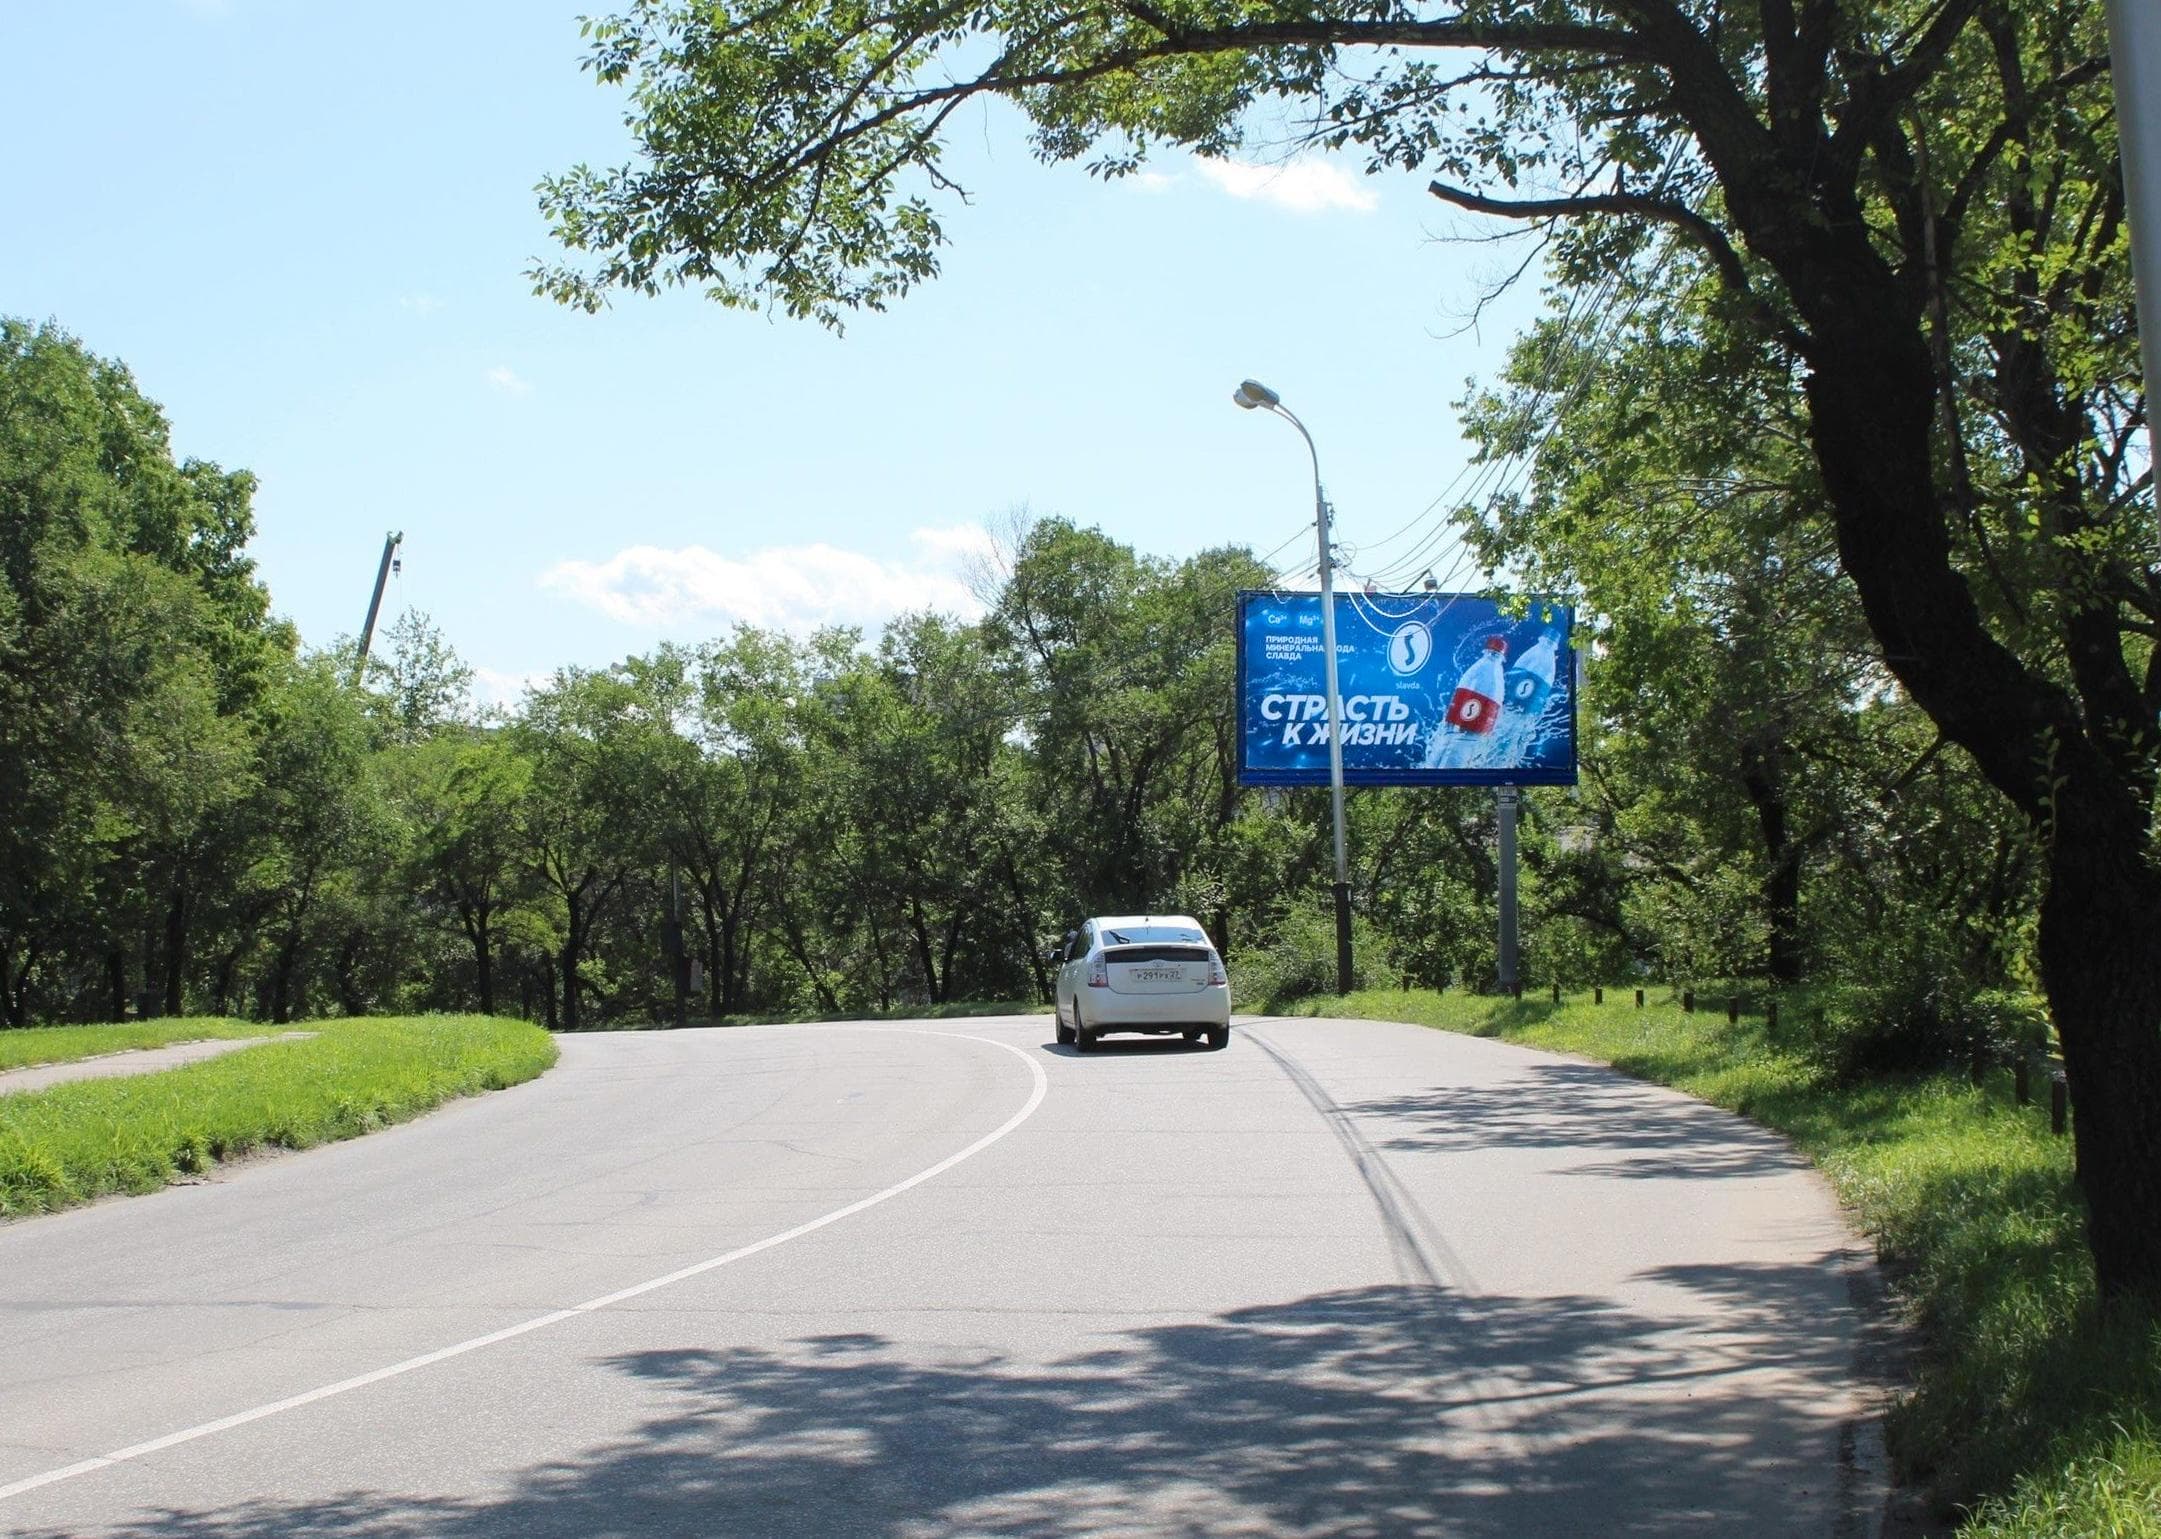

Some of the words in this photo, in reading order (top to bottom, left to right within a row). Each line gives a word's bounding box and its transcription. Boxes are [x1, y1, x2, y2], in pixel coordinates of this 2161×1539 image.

[1265, 635, 1318, 644] ПРИРОДНАЯ
[1265, 643, 1326, 653] МИНЕРАЛЬНА
[1334, 644, 1355, 653] ОДА
[1265, 651, 1302, 660] СЛАВДА
[1395, 681, 1420, 690] slavda
[1260, 694, 1410, 722] СТРАСТЬ
[1281, 723, 1306, 745] К
[1307, 723, 1418, 745] ЖИЗНИ
